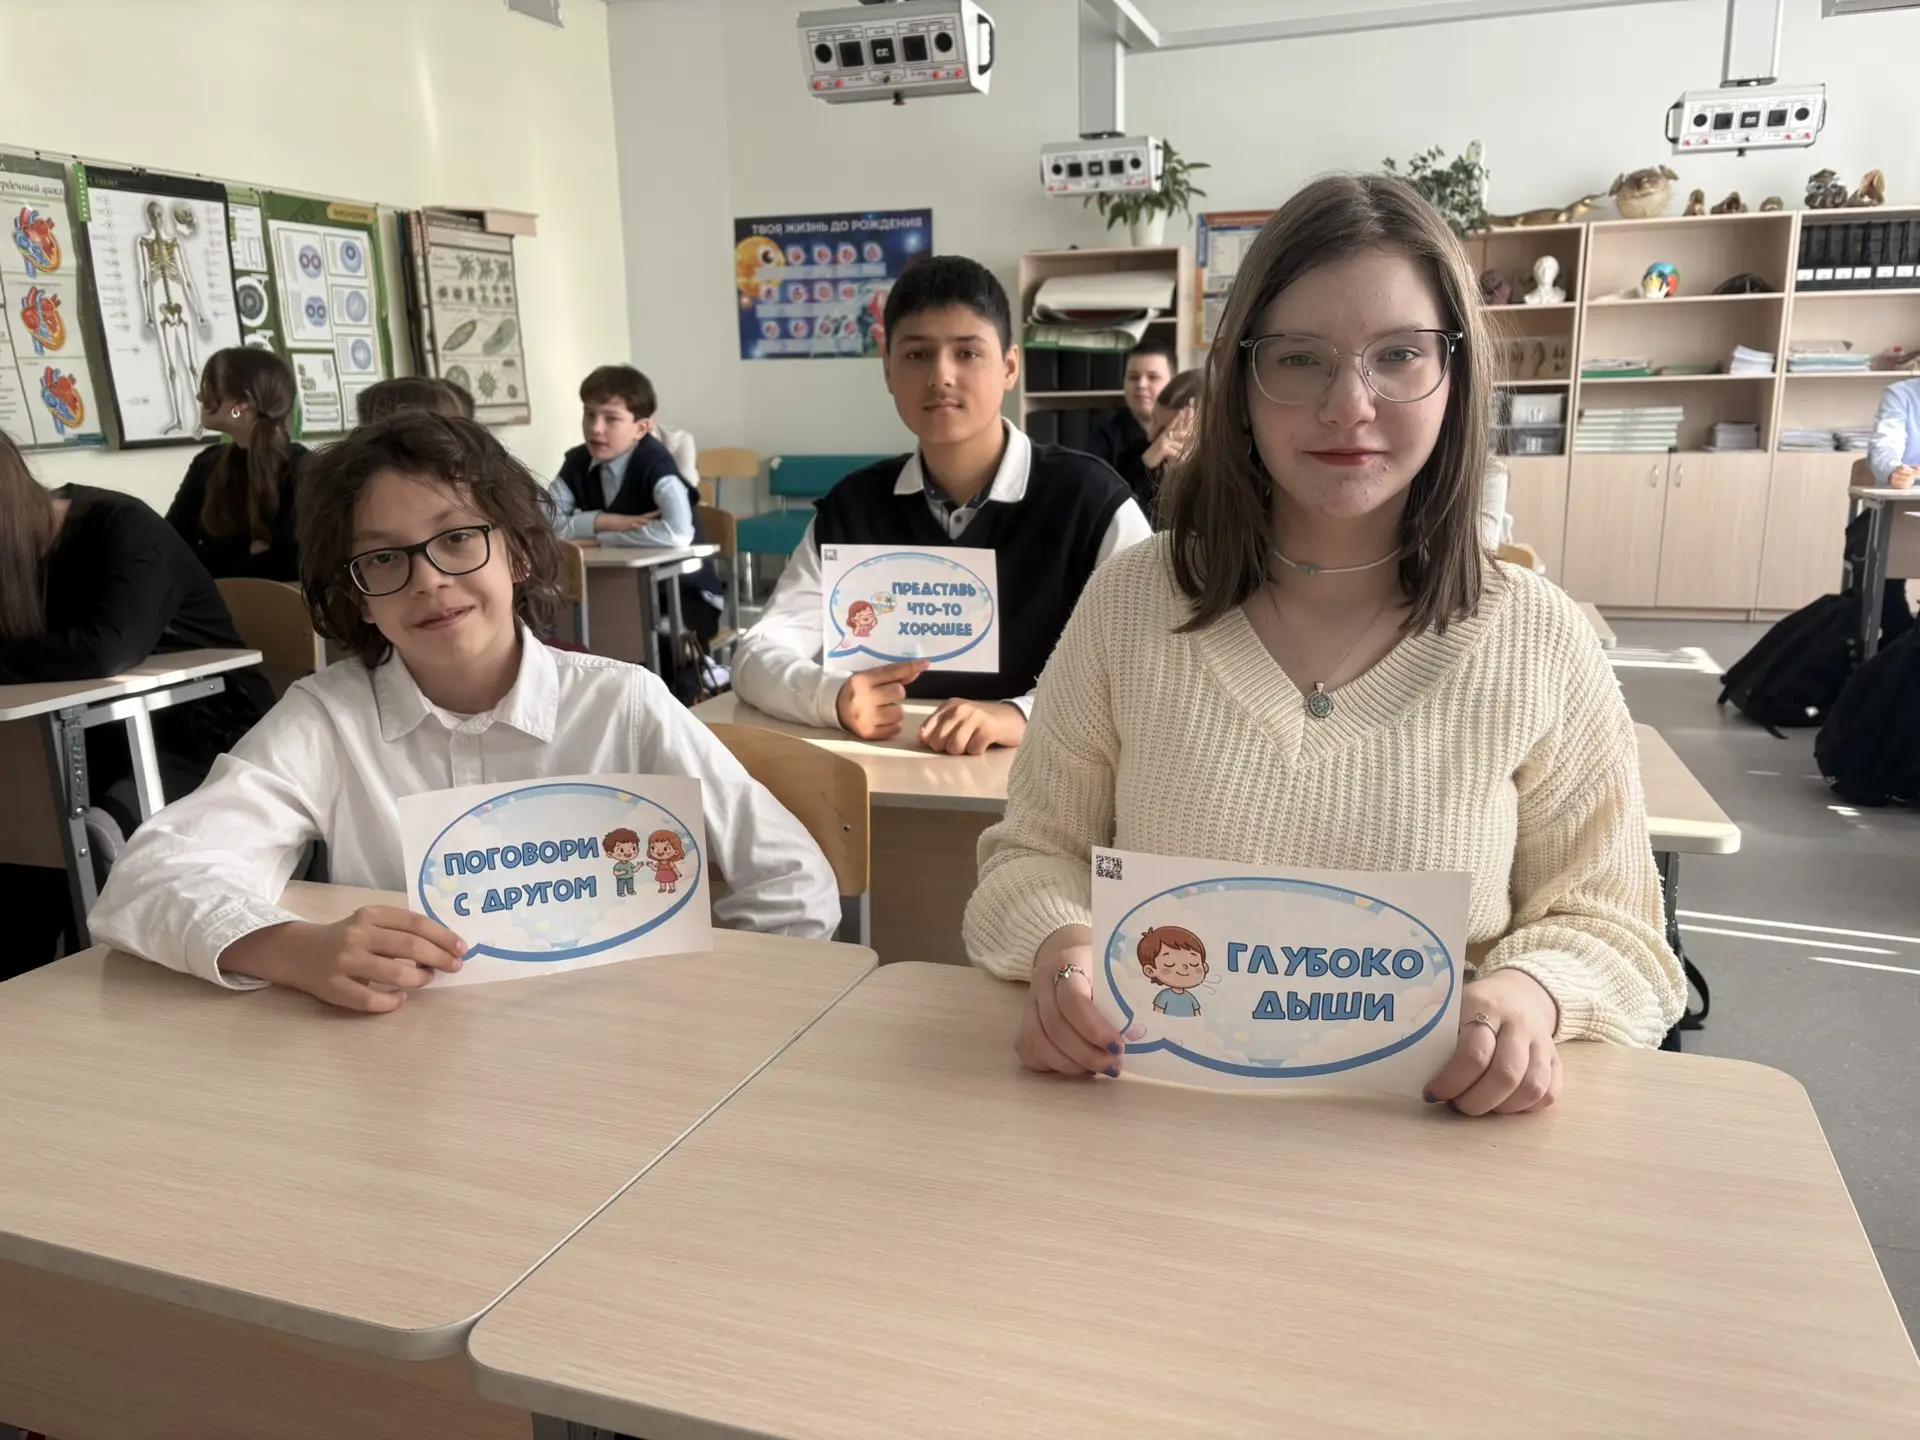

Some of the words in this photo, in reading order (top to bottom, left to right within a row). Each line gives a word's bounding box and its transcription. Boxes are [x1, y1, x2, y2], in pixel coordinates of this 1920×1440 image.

[752, 223, 783, 235] ТВОЯ
[785, 221, 829, 234] ЖИЗНЬ
[830, 220, 849, 232] ДО
[851, 217, 923, 231] РОЖДЕНИЯ
[892, 582, 976, 597] ПРЕДСТАВЬ
[907, 602, 962, 616] ЧТО-ТО
[898, 622, 973, 636] ХОРОШЕЕ
[444, 837, 599, 876] ПОГОВОРИ
[454, 893, 470, 916] С
[482, 875, 597, 914] ДРУГОМ
[1227, 942, 1424, 979] ГЛУБОКО
[1252, 991, 1394, 1022] ДЫШИ
